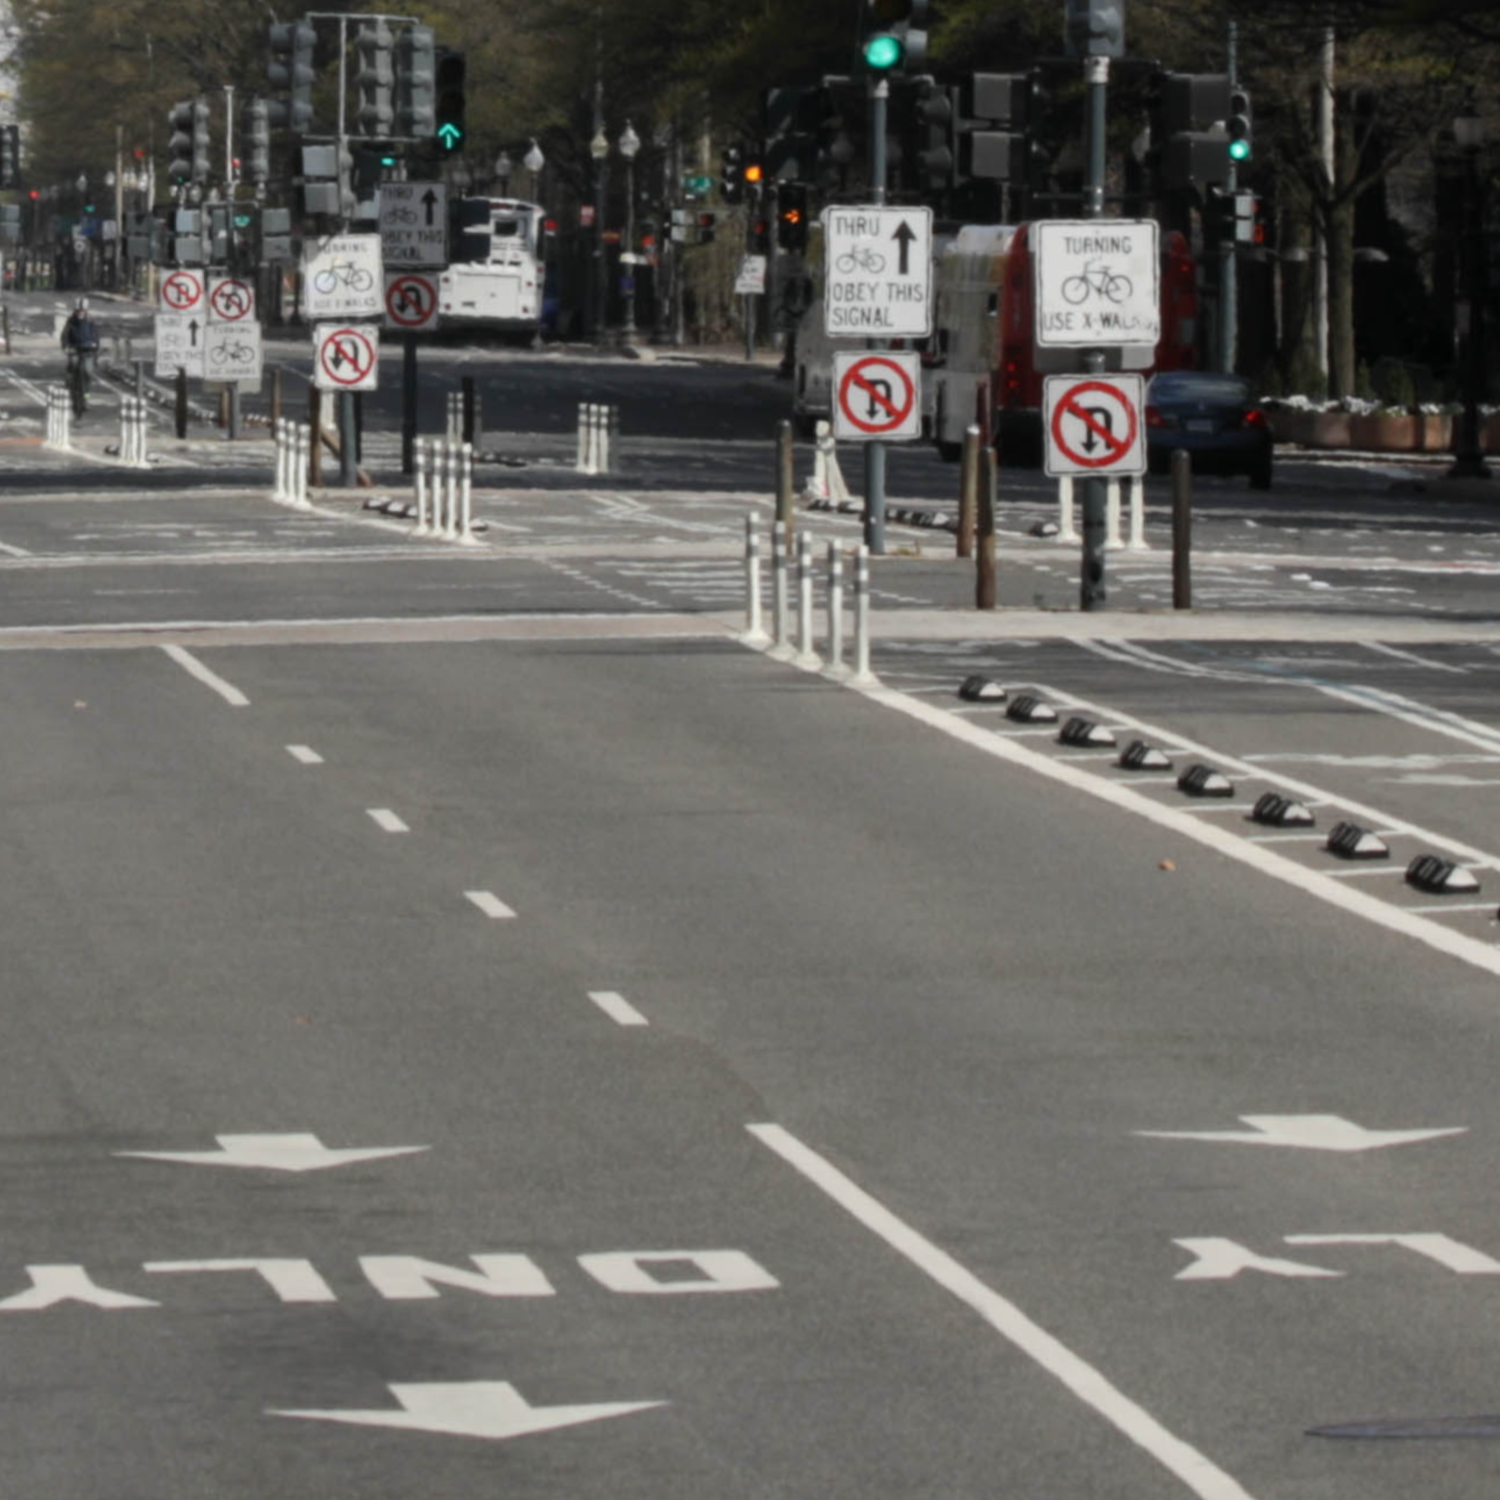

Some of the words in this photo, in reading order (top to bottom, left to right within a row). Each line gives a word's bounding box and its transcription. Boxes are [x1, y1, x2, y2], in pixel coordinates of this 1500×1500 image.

[835, 216, 880, 236] THRU
[1063, 235, 1133, 255] TURNING
[832, 281, 879, 302] OBEY
[886, 282, 924, 303] THIS
[831, 306, 894, 328] SIGNAL
[1043, 311, 1075, 331] USE
[1171, 1232, 1500, 1279] LY
